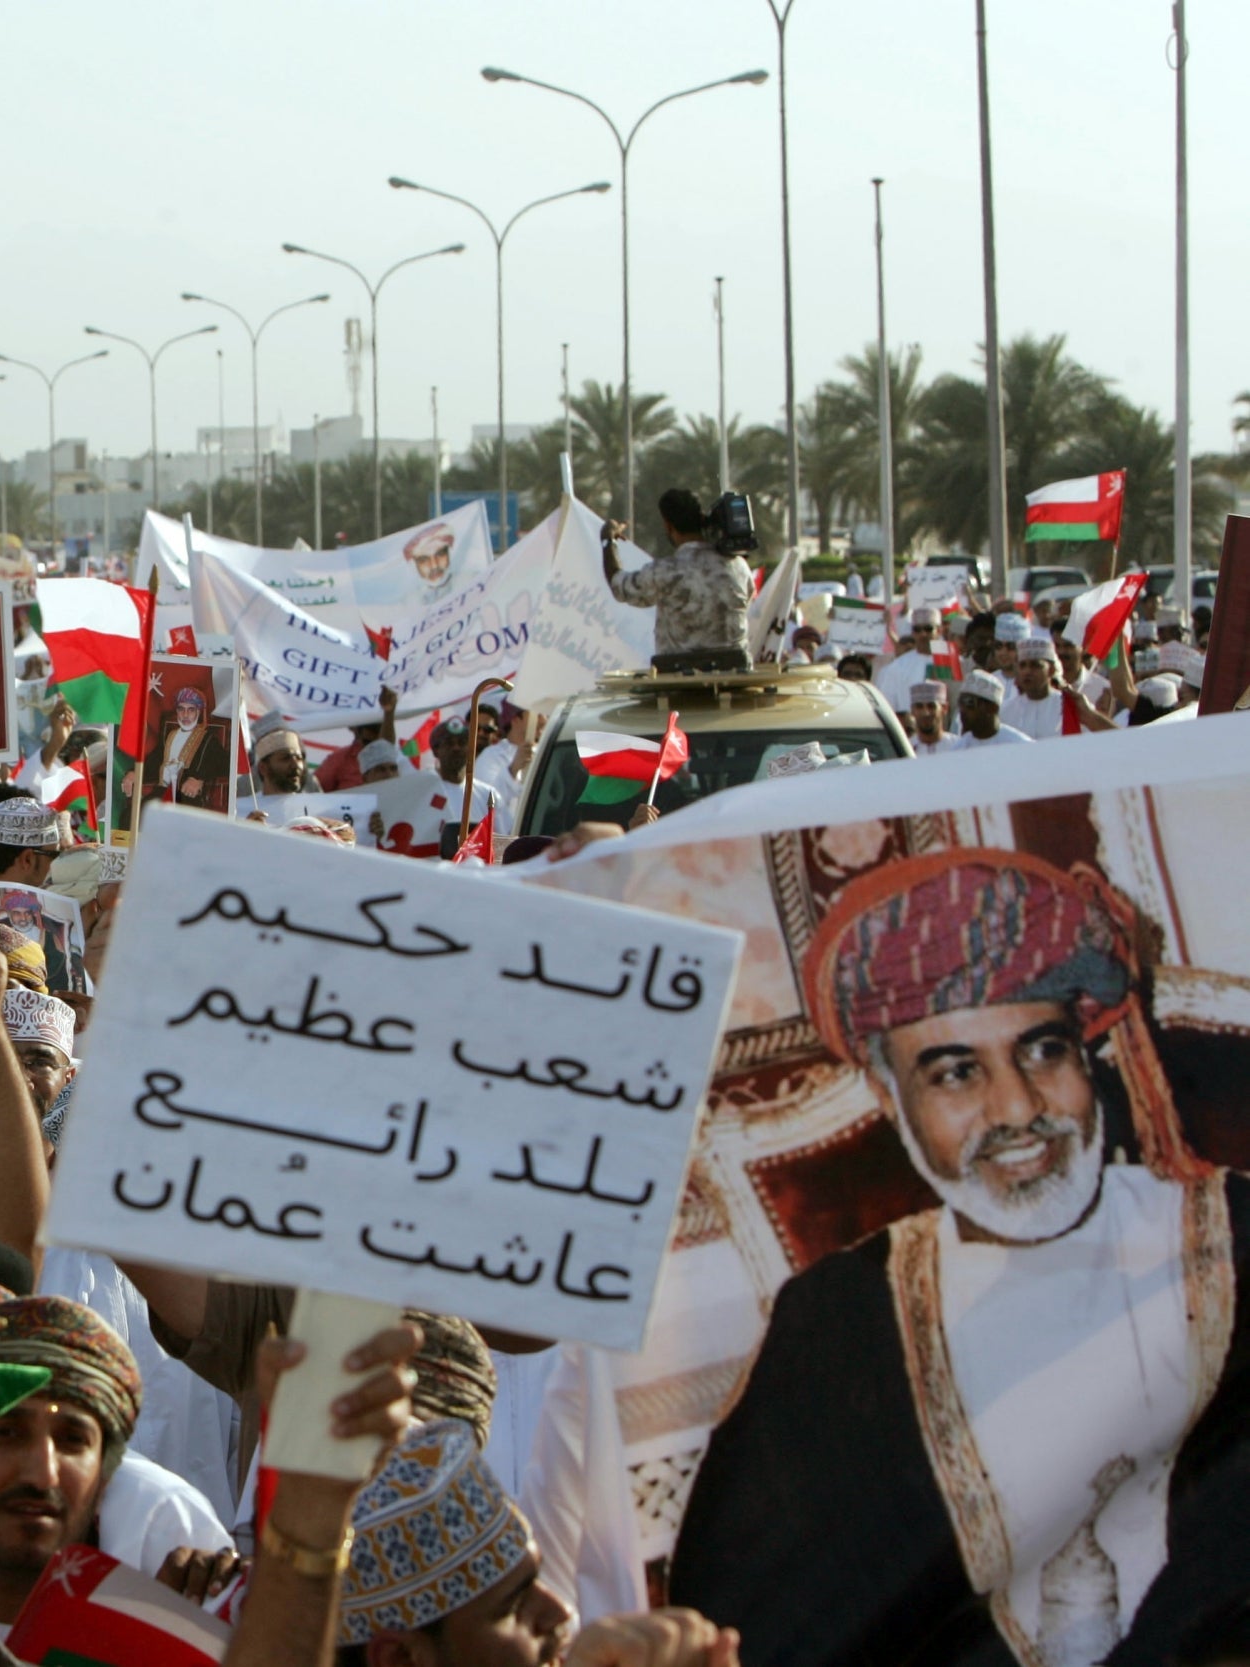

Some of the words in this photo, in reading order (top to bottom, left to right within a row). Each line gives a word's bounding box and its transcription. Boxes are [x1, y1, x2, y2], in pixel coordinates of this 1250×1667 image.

[240, 655, 421, 709] ESIDENE
[283, 647, 369, 685] GIFT
[379, 649, 416, 682] OF
[179, 889, 470, 958] حكيم
[501, 944, 702, 1013] قائد
[168, 976, 414, 1053] عظيم
[452, 1041, 684, 1111] شعب
[134, 1071, 458, 1181] رائع
[492, 1136, 654, 1220] بلد
[360, 1220, 632, 1302] عاشت
